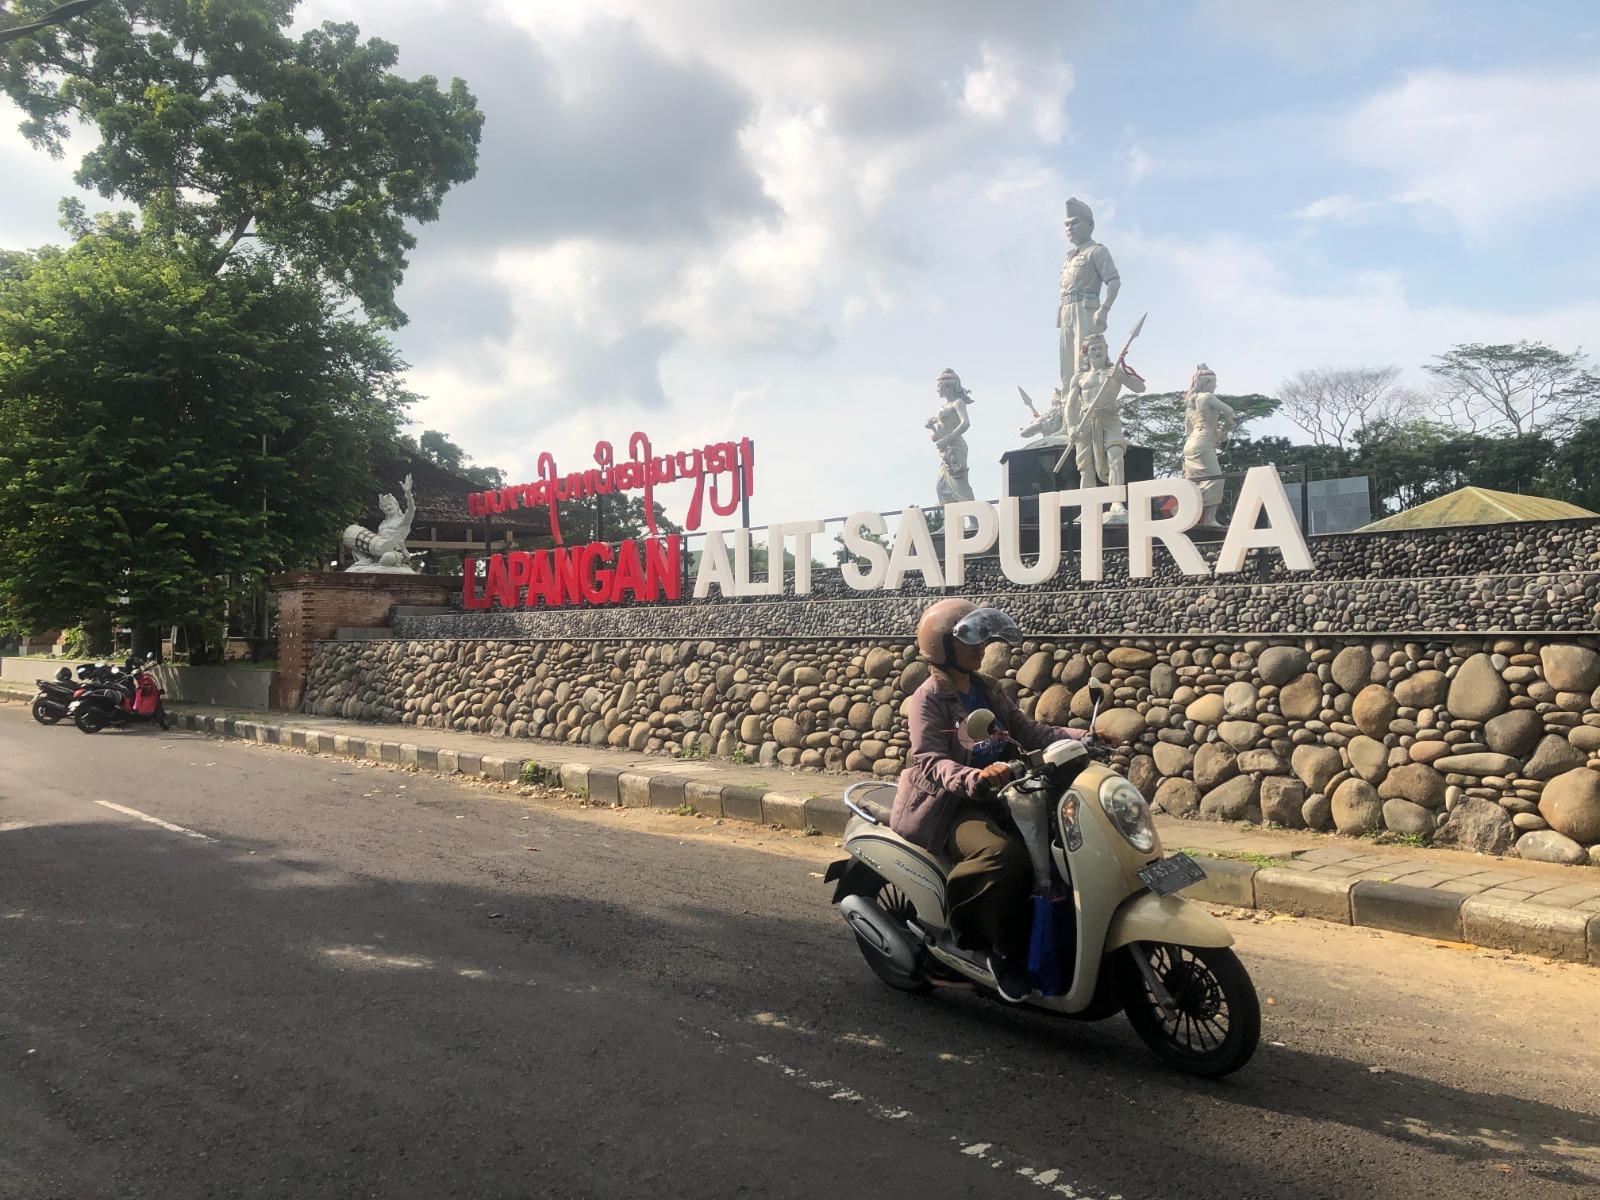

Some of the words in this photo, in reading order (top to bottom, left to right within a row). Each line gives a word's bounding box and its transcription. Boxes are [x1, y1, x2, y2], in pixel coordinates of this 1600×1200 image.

[463, 533, 682, 609] LAPANGAN
[693, 519, 825, 598] ALIT
[841, 465, 1315, 590] SAPUTRA
